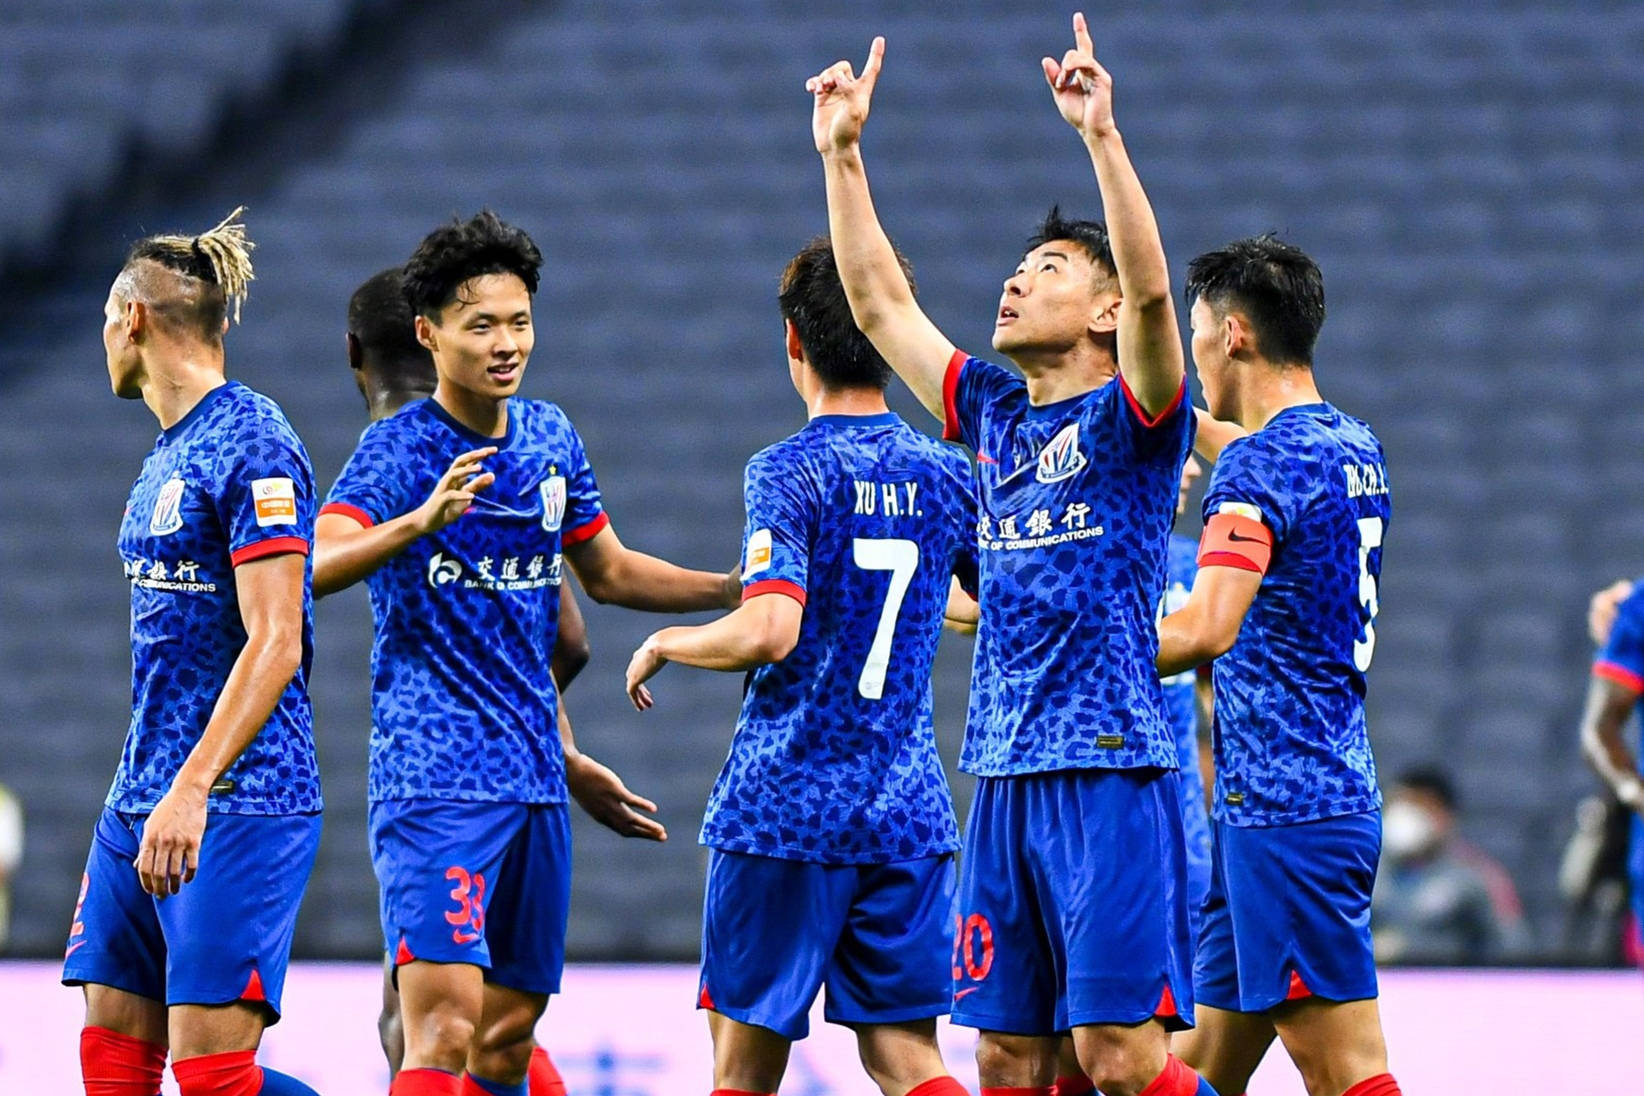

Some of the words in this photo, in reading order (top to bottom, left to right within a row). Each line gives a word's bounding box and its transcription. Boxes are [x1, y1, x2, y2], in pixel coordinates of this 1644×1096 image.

[854, 481, 876, 515] XU
[882, 482, 923, 516] H.Y.
[990, 541, 1004, 551] OF
[1005, 526, 1104, 550] COMMUNICATIONS
[853, 538, 919, 700] 7
[1354, 516, 1383, 672] 5
